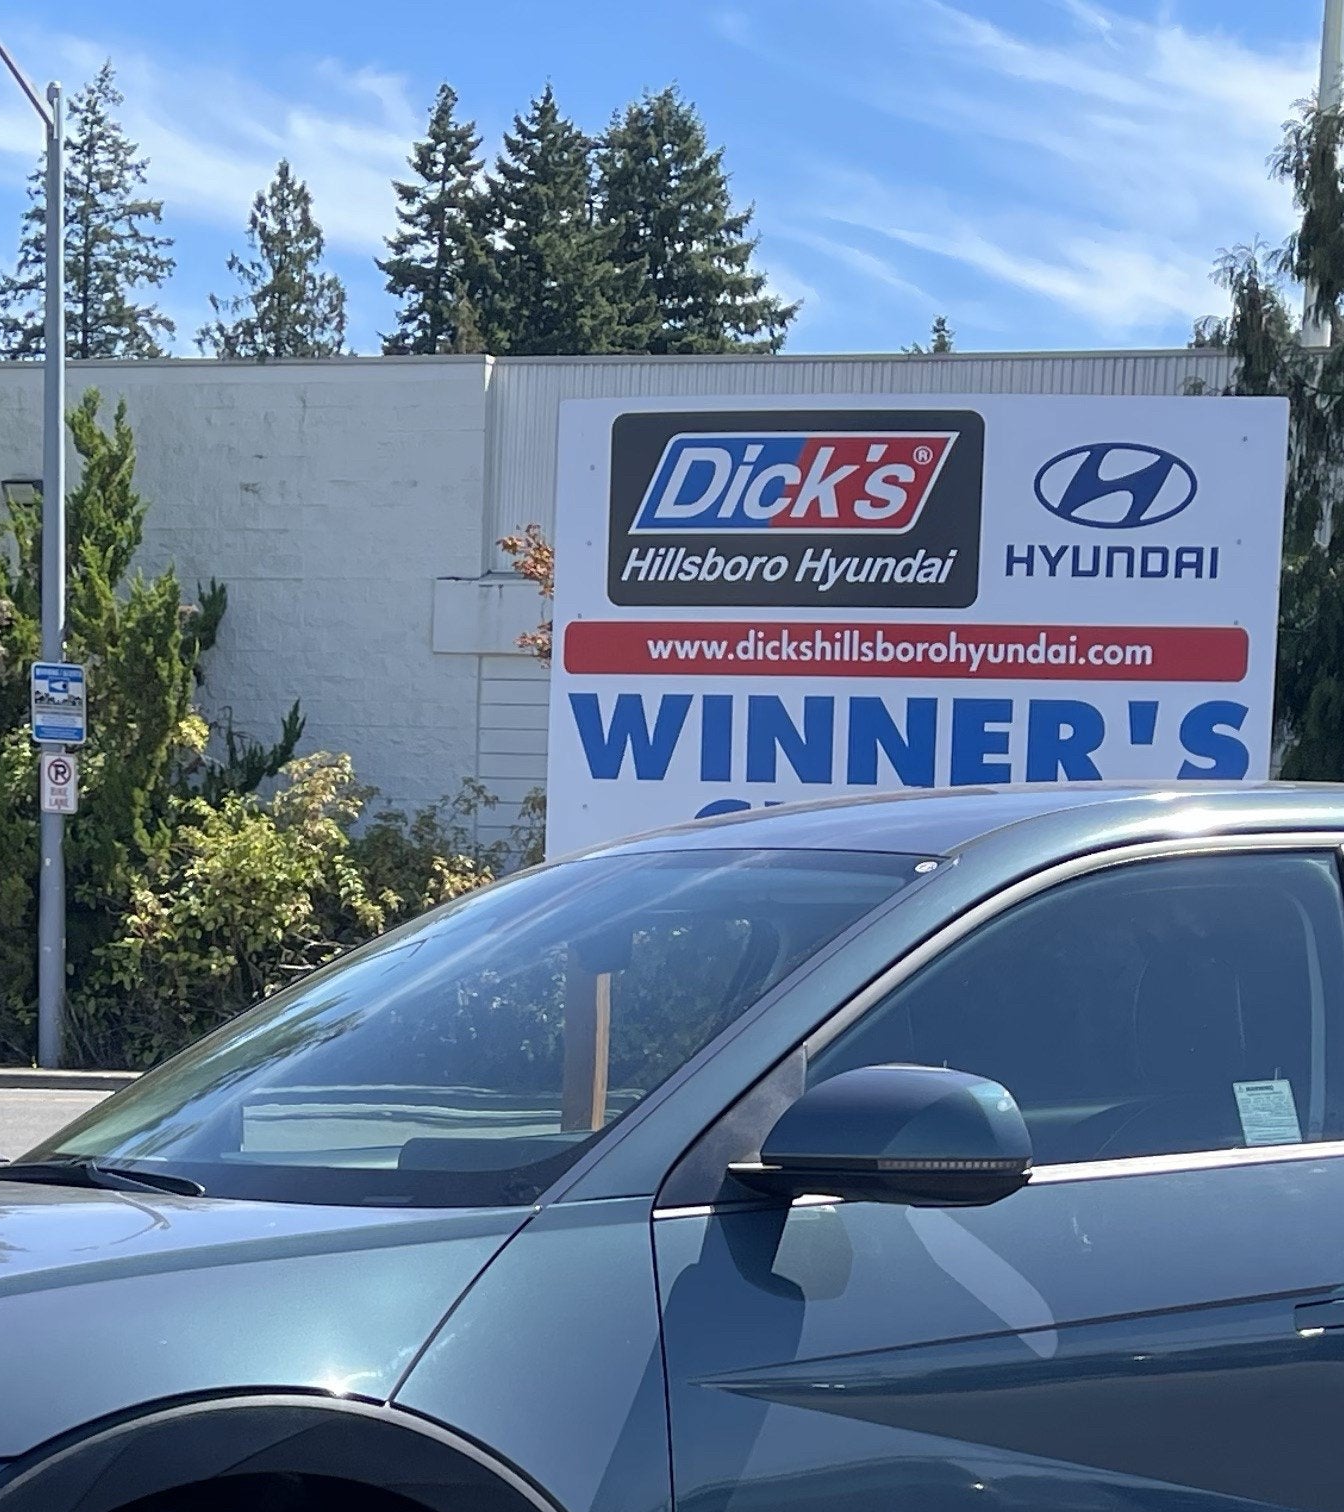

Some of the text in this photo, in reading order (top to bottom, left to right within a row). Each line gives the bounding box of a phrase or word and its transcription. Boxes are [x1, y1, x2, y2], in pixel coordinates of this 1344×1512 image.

[654, 444, 916, 520] Dick's
[621, 547, 958, 592] Hillsboro Hyundai
[1005, 544, 1220, 579] HYUNDAI
[647, 629, 1152, 672] www.dickshillsborohyundai.com
[567, 692, 1250, 787] WINNER'S
